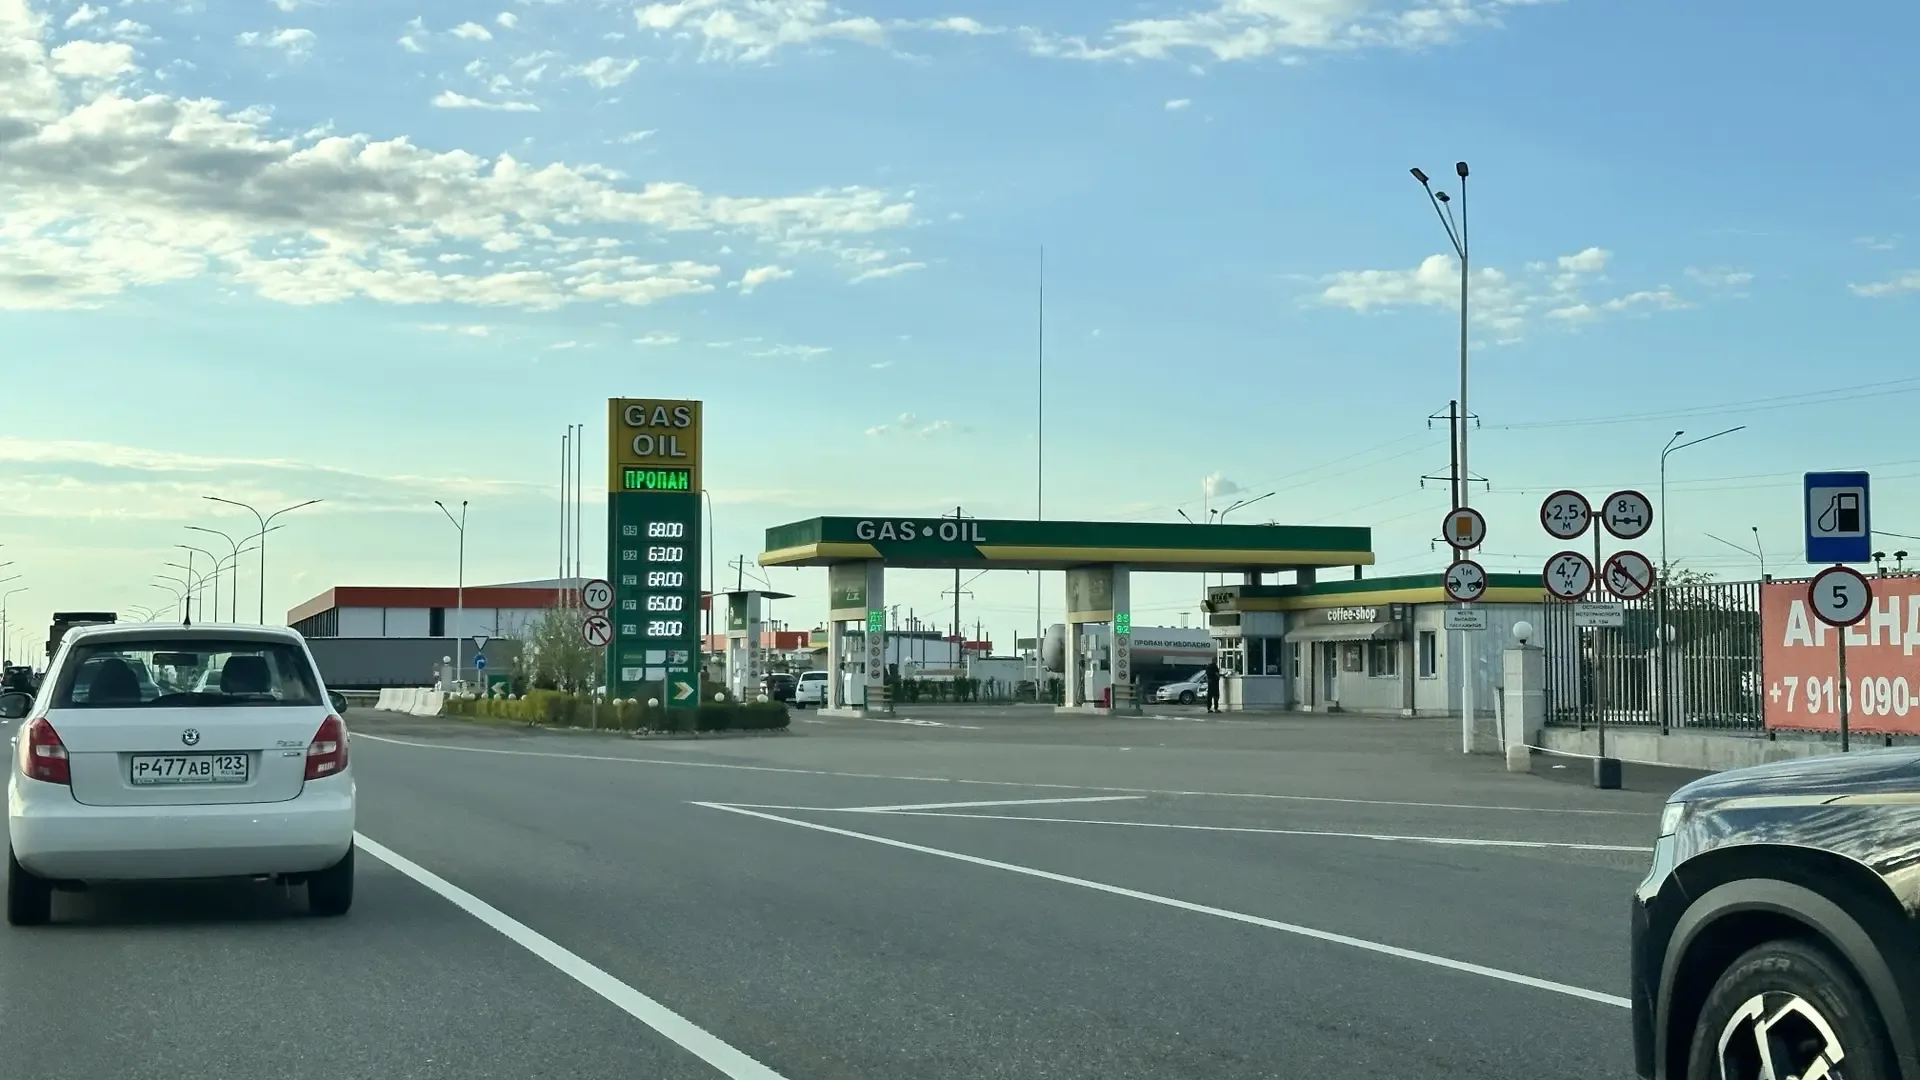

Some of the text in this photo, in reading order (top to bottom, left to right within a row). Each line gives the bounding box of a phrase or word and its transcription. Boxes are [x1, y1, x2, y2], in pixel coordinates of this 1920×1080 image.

[624, 405, 691, 428] GAS
[632, 434, 687, 456] OIL
[625, 470, 688, 489] ПРОПАН
[1553, 504, 1579, 521] 2,5
[623, 522, 683, 538] 95 68.00
[856, 520, 986, 542] GAS OIL
[623, 547, 683, 562] 92 63.00
[1555, 563, 1581, 579] 4,7
[589, 589, 607, 602] 70
[647, 596, 683, 611] 65.00
[1832, 586, 1849, 609] 5
[647, 621, 683, 636] 28.00
[1769, 676, 1799, 713] +7
[1861, 676, 1920, 716] 090-
[138, 756, 242, 777] Р477АВ 123
